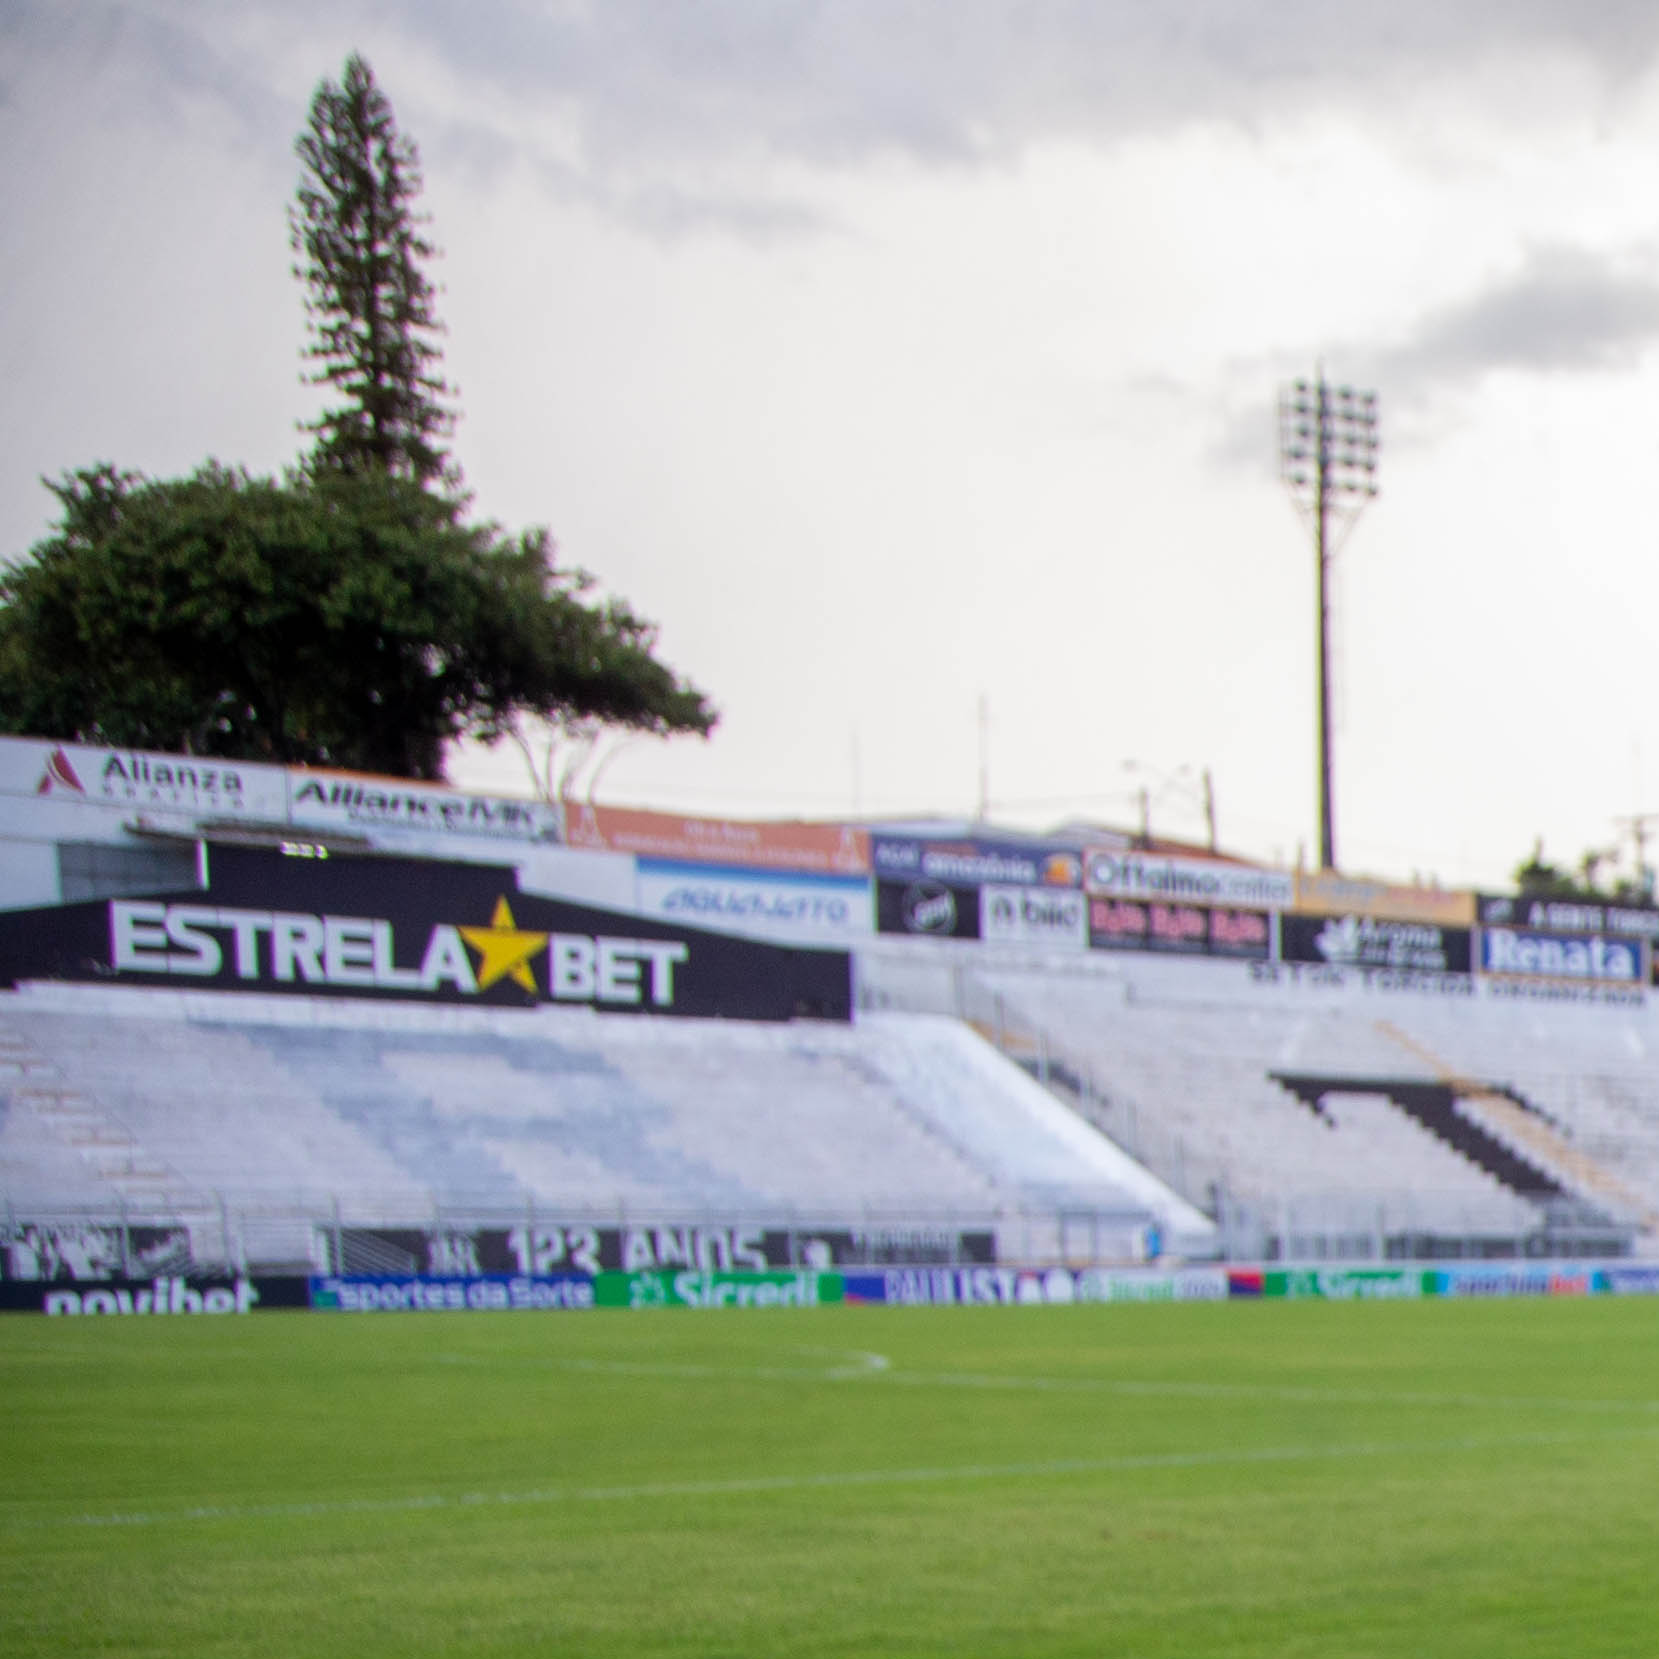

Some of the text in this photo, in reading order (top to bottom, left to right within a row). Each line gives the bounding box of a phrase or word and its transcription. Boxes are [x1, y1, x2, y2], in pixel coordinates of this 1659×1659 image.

[104, 752, 243, 793] Alianza
[111, 899, 688, 1004] ESTRELA BET
[1487, 927, 1635, 980] Renata
[674, 1268, 819, 1309] Sicredi
